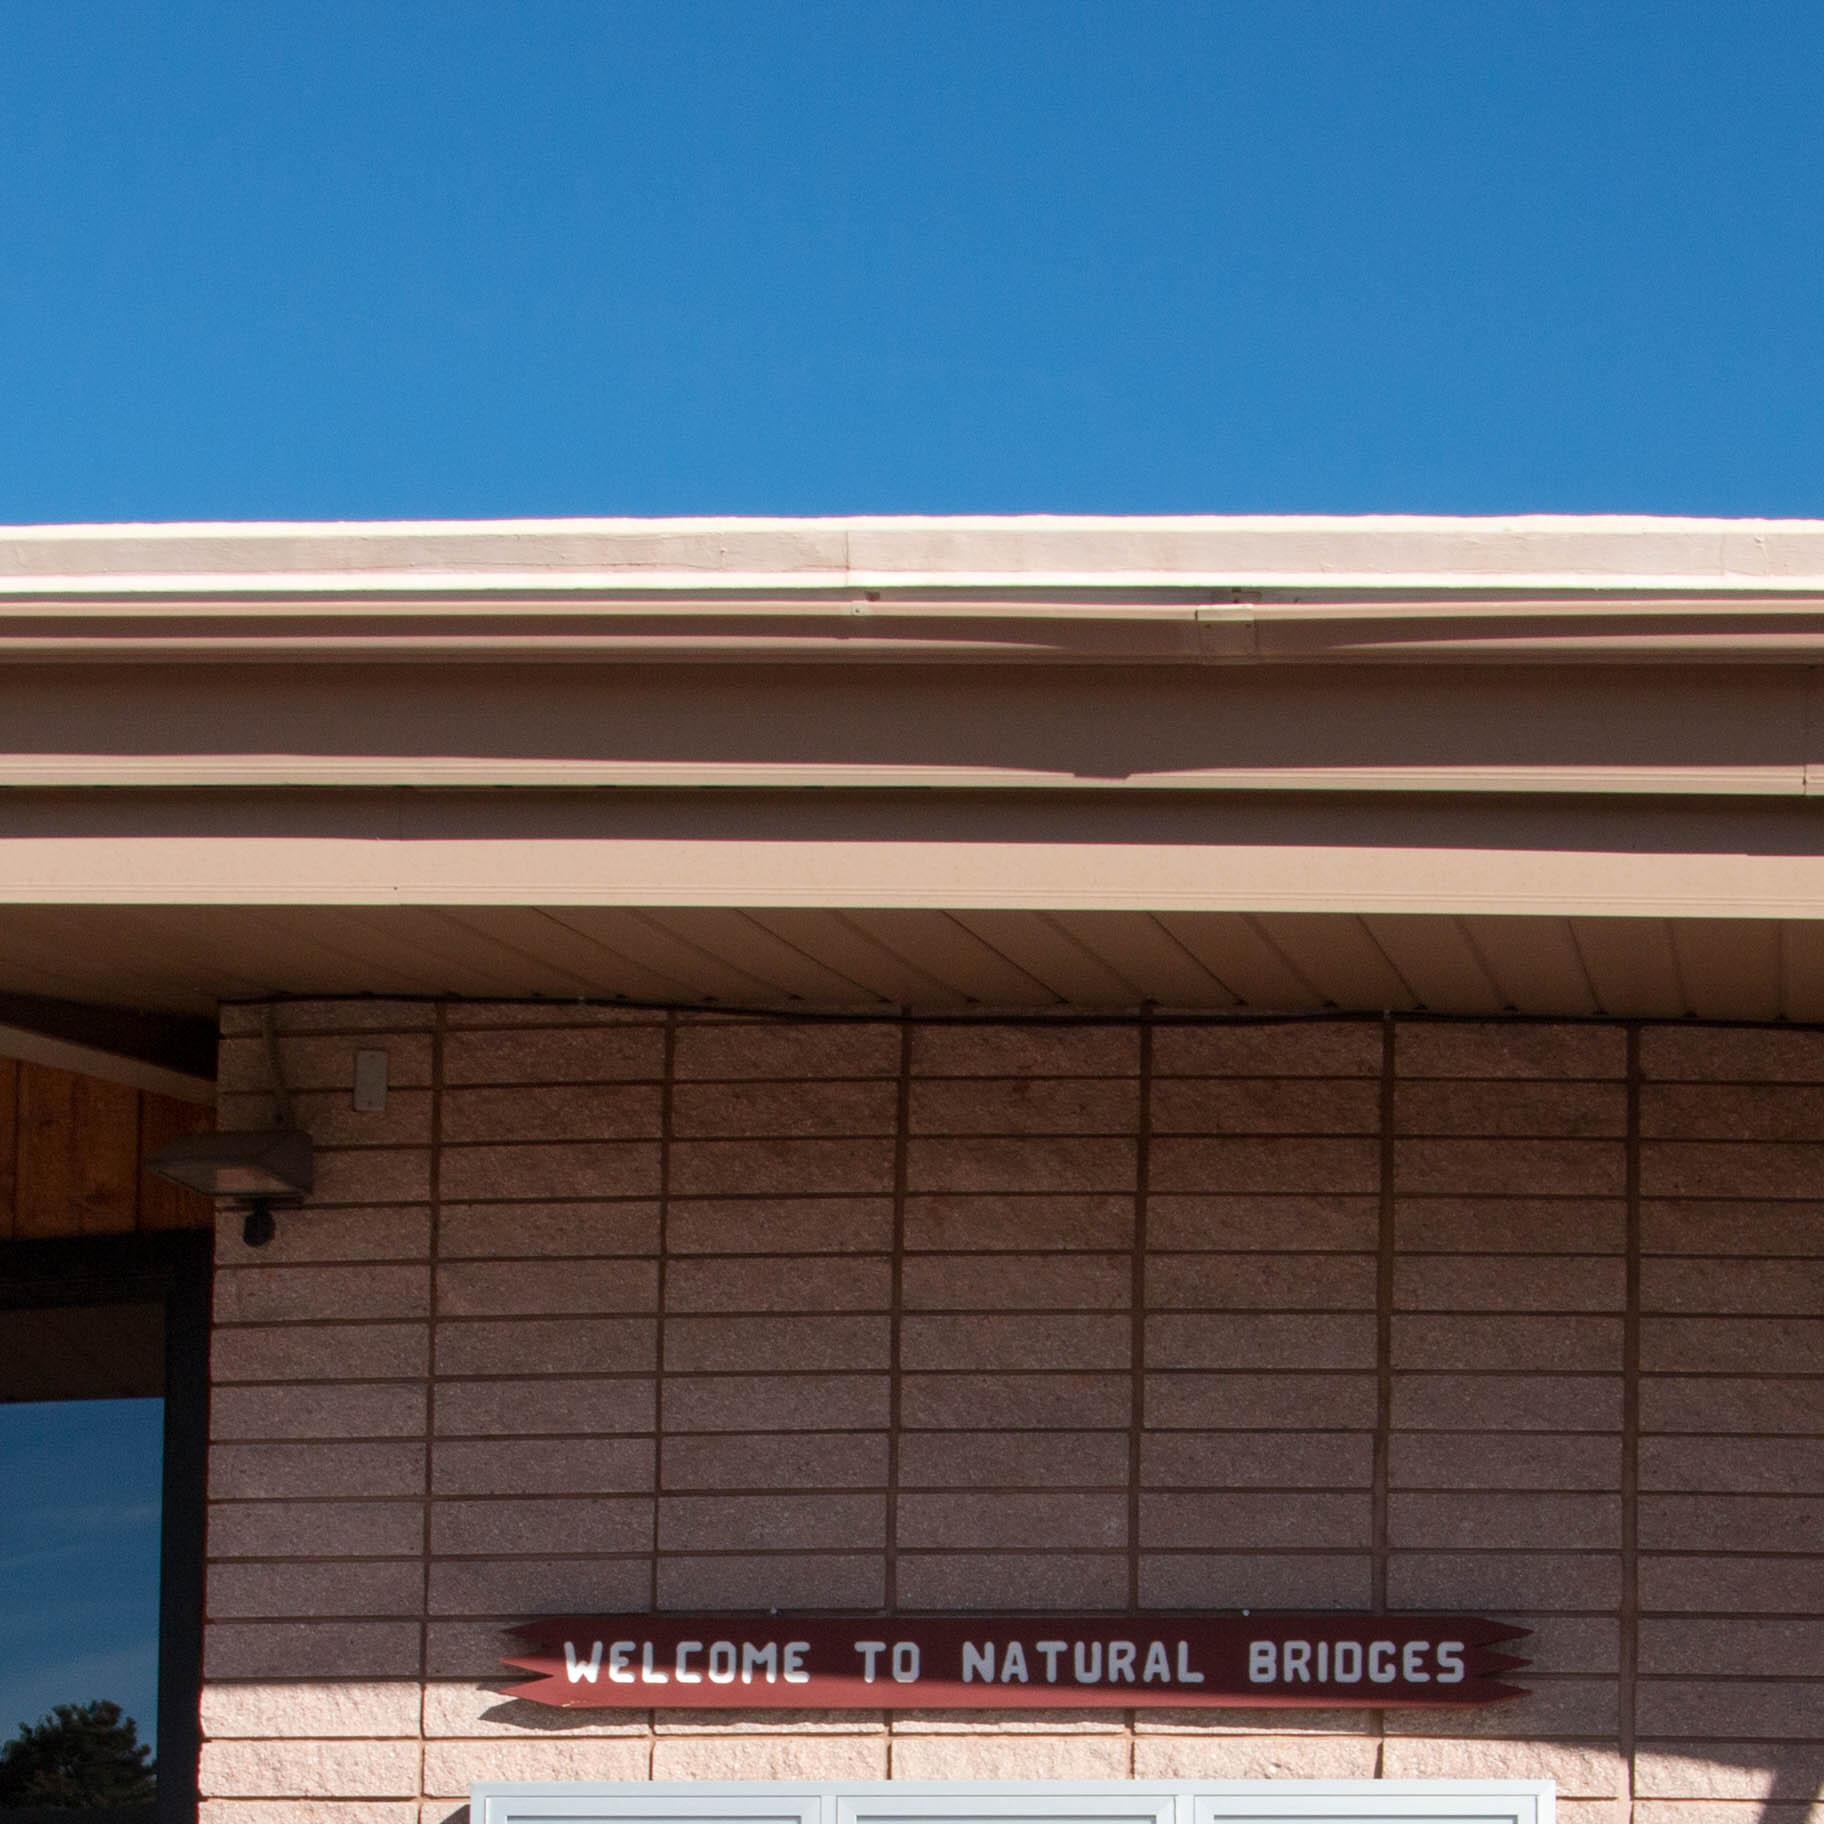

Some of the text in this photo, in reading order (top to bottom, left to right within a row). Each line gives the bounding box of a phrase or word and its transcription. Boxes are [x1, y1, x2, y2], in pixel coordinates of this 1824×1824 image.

[564, 1640, 1464, 1685] WELCOME TO NATURAL BRIDGES
